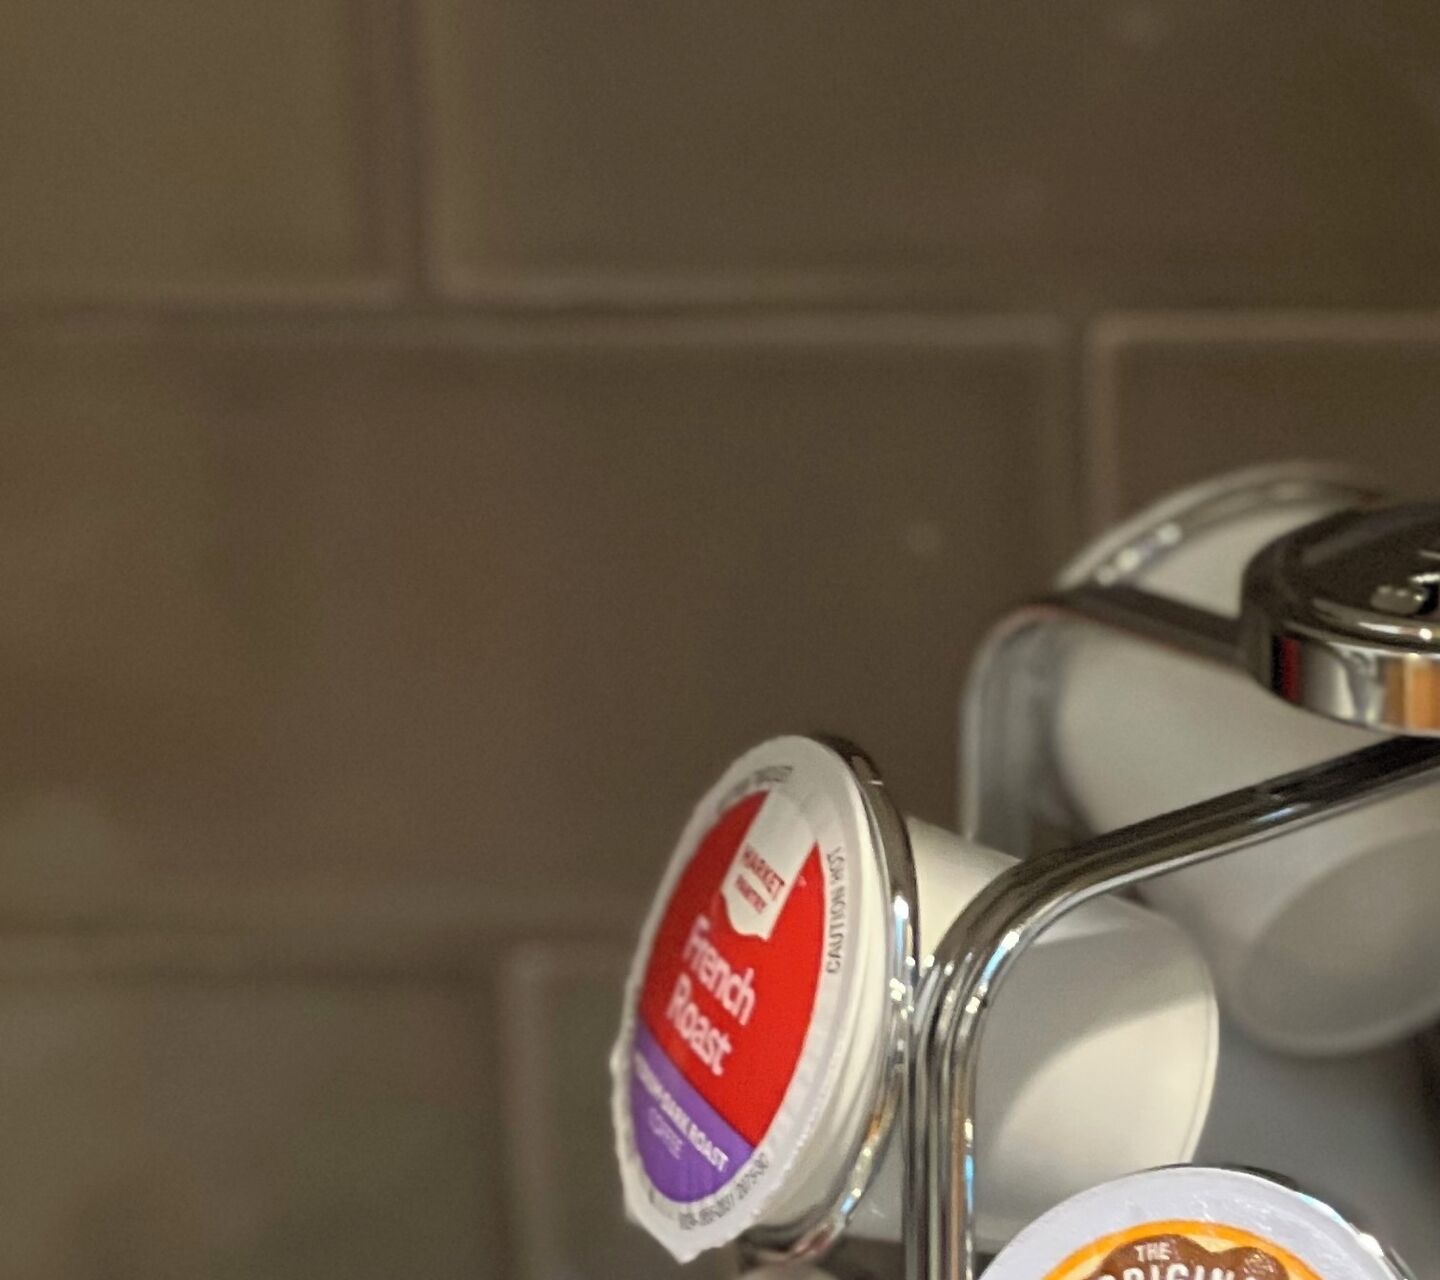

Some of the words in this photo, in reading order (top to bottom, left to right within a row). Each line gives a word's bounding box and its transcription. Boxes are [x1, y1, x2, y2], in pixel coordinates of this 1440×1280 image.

[682, 914, 756, 1026] French
[826, 886, 846, 974] CAUTION
[666, 975, 733, 1077] Roast
[1135, 1242, 1171, 1261] THE
